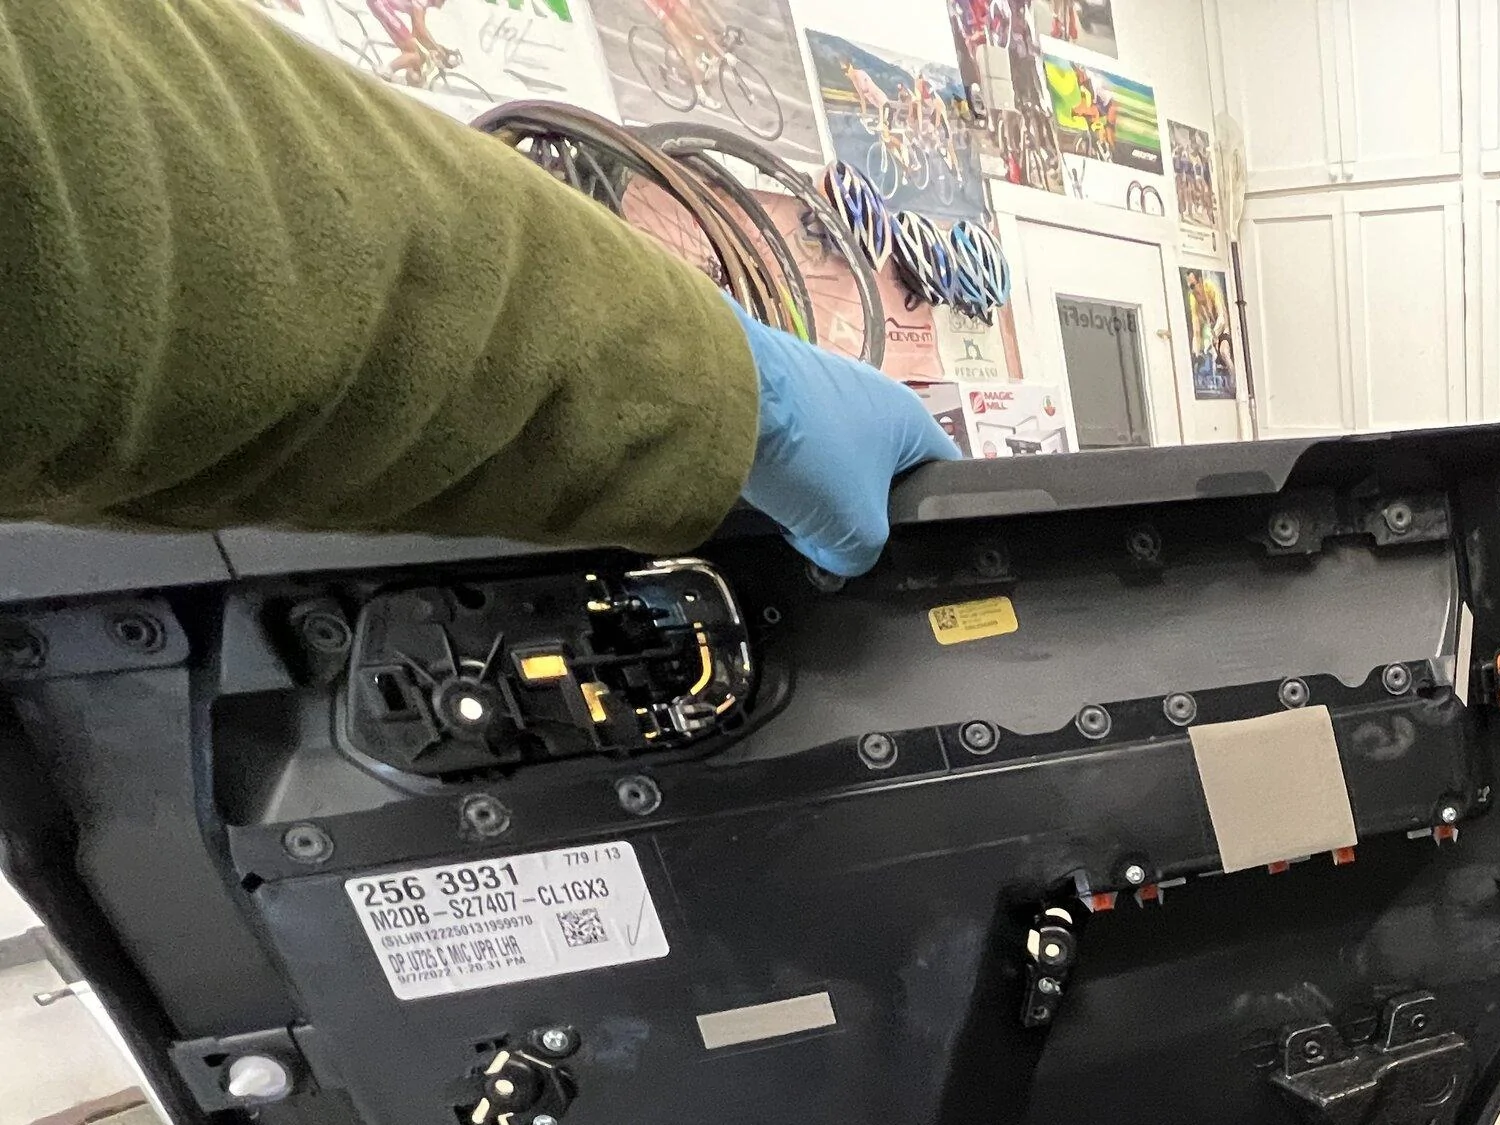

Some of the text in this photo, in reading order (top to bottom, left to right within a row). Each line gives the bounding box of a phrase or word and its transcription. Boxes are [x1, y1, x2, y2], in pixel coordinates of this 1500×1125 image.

[563, 852, 590, 867] 779
[605, 847, 622, 860] 13
[357, 863, 519, 908] 256 3931
[447, 942, 472, 965] MIC
[469, 937, 498, 963] UPR
[494, 934, 523, 957] LHR
[506, 955, 527, 968] PM
